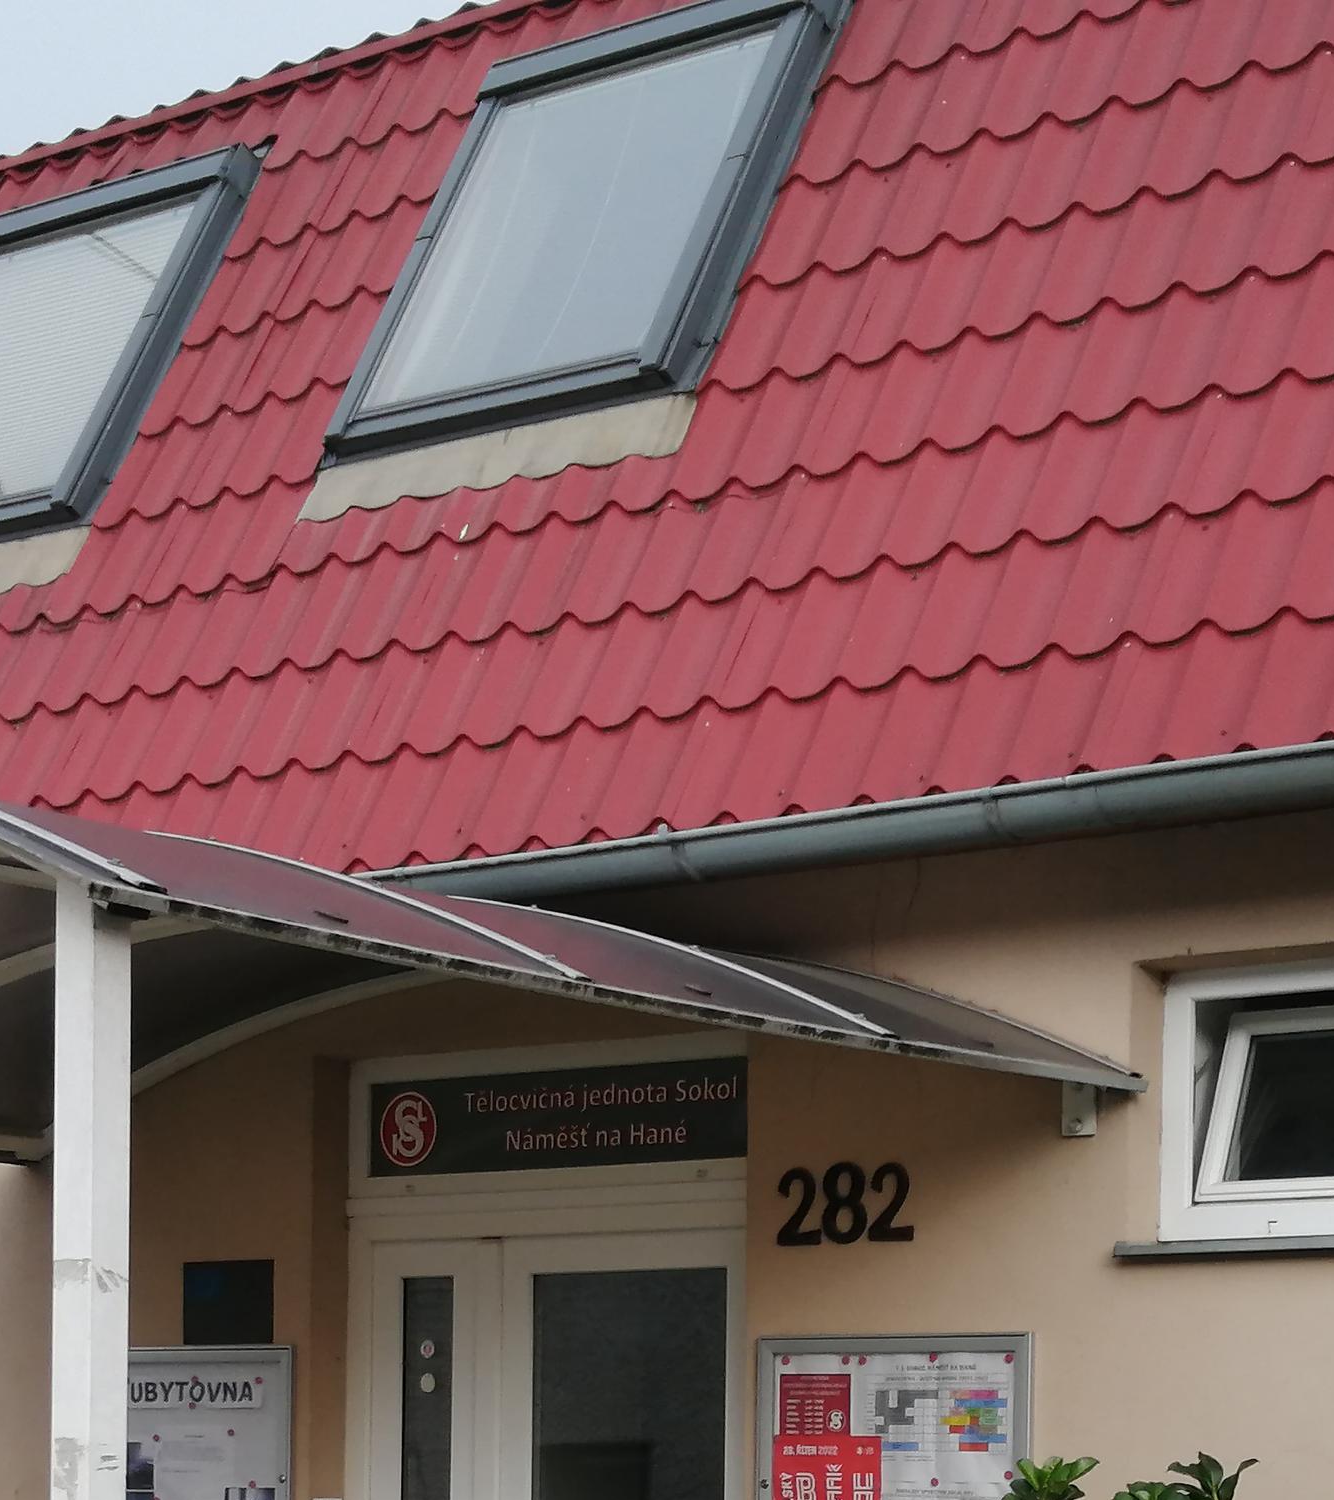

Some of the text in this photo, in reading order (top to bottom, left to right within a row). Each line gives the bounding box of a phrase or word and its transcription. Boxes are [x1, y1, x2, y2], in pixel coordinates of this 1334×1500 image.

[464, 1076, 738, 1114] Tělocvičná jednota Sokol
[506, 1120, 687, 1153] Náměšť na Hané
[777, 1161, 914, 1246] 282
[130, 1380, 253, 1403] UBYTOVNA
